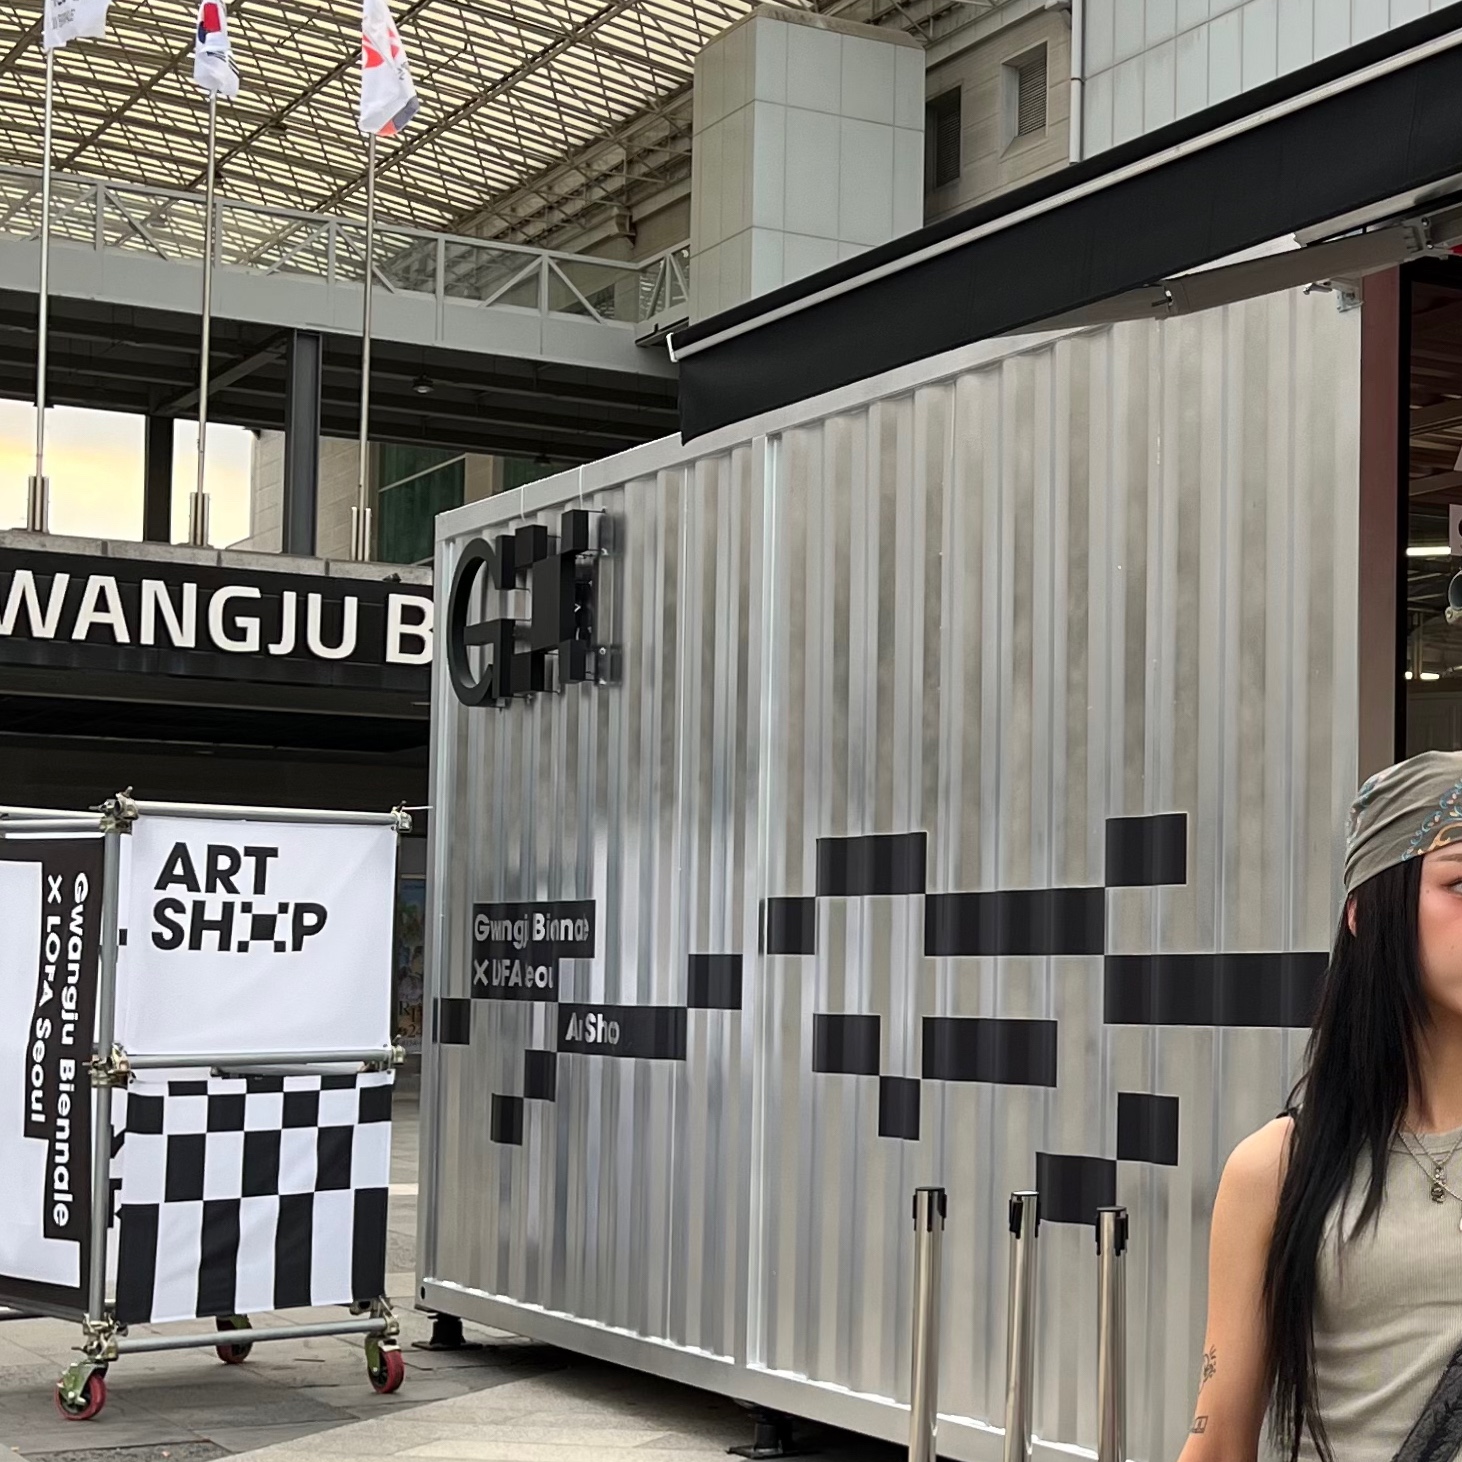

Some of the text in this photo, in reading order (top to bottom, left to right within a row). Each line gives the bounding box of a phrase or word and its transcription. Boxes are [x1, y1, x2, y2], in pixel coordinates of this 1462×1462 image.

[154, 841, 279, 895] ART
[30, 874, 63, 1123] X LOFA Seoul
[52, 872, 89, 1228] Gwangju Biennale
